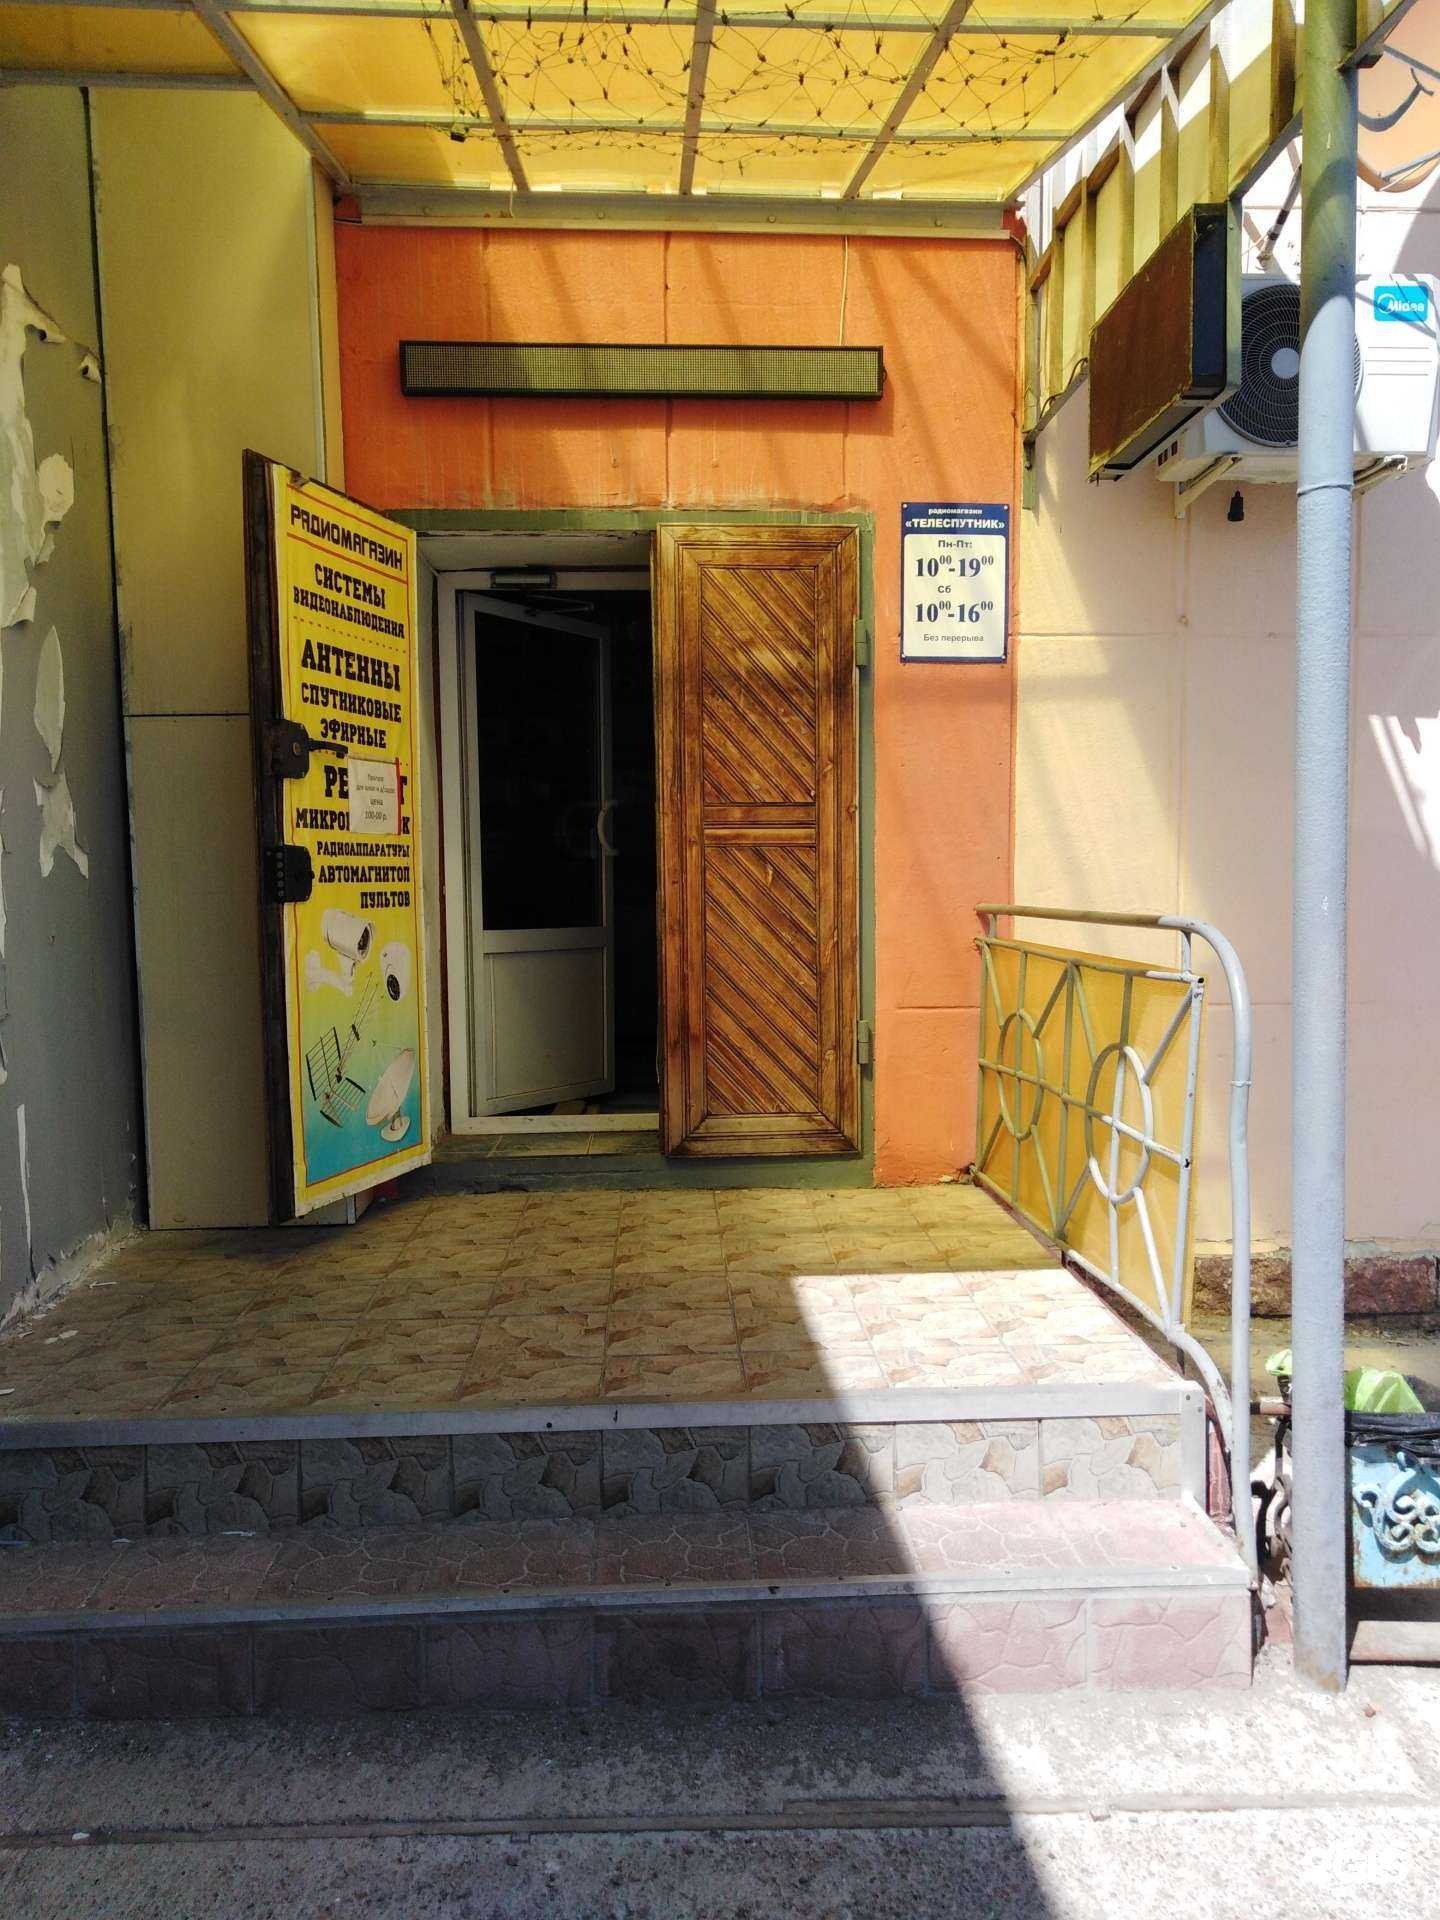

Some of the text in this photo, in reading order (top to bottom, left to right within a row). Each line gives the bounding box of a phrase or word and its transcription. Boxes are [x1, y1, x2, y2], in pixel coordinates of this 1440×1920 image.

[905, 518, 1005, 529] «ТЕЛЕСПУТНИК»
[928, 508, 983, 516] радиомагазин
[290, 504, 403, 571] РАДИОМАГАЗИН
[938, 540, 973, 549] Пн-Пт:
[314, 563, 386, 610] СИСТЕМЫ
[293, 586, 405, 639] ВИДЕОНАБЛЮДЕНИЯ
[923, 634, 984, 646] Без перерыва
[301, 638, 401, 692] АНТЕННЫ
[301, 682, 402, 723] СПУТНИКОВЫЕ
[320, 719, 387, 749] ЭФИРНЫЕ
[317, 841, 410, 858] РАДИОАППАРАТУРЫ
[360, 891, 411, 909] ПУЛЬТОВ
